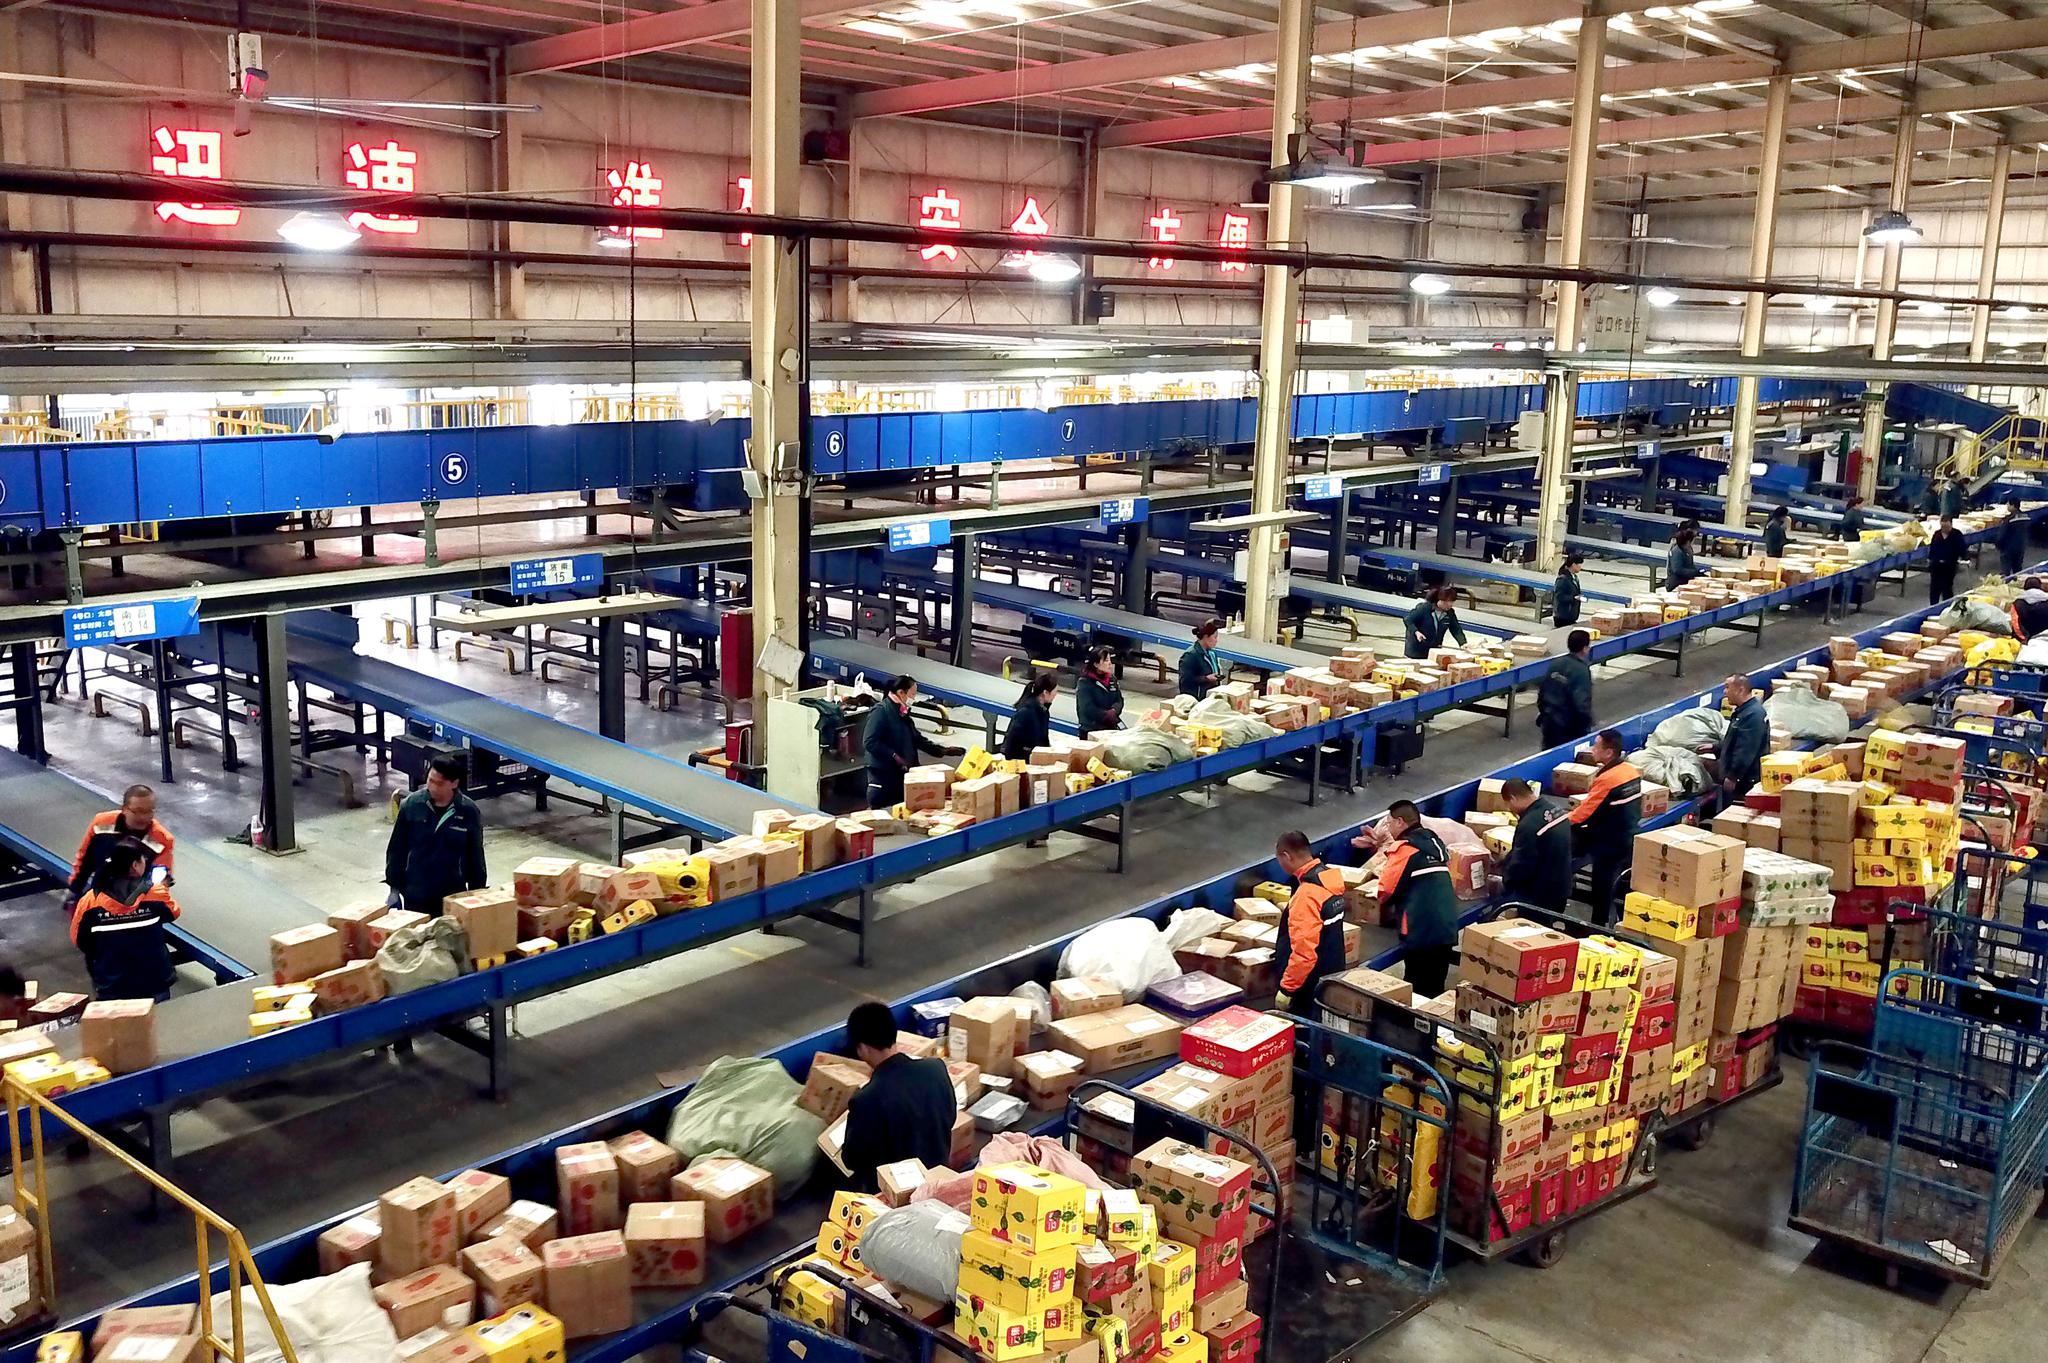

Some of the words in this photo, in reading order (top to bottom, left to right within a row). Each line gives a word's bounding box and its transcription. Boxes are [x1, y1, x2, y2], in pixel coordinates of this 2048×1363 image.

[1065, 421, 1074, 439] 7
[829, 434, 841, 454] 6
[446, 456, 463, 480] 5
[554, 572, 566, 583] 15
[123, 621, 133, 633] 13
[138, 619, 148, 631] 14
